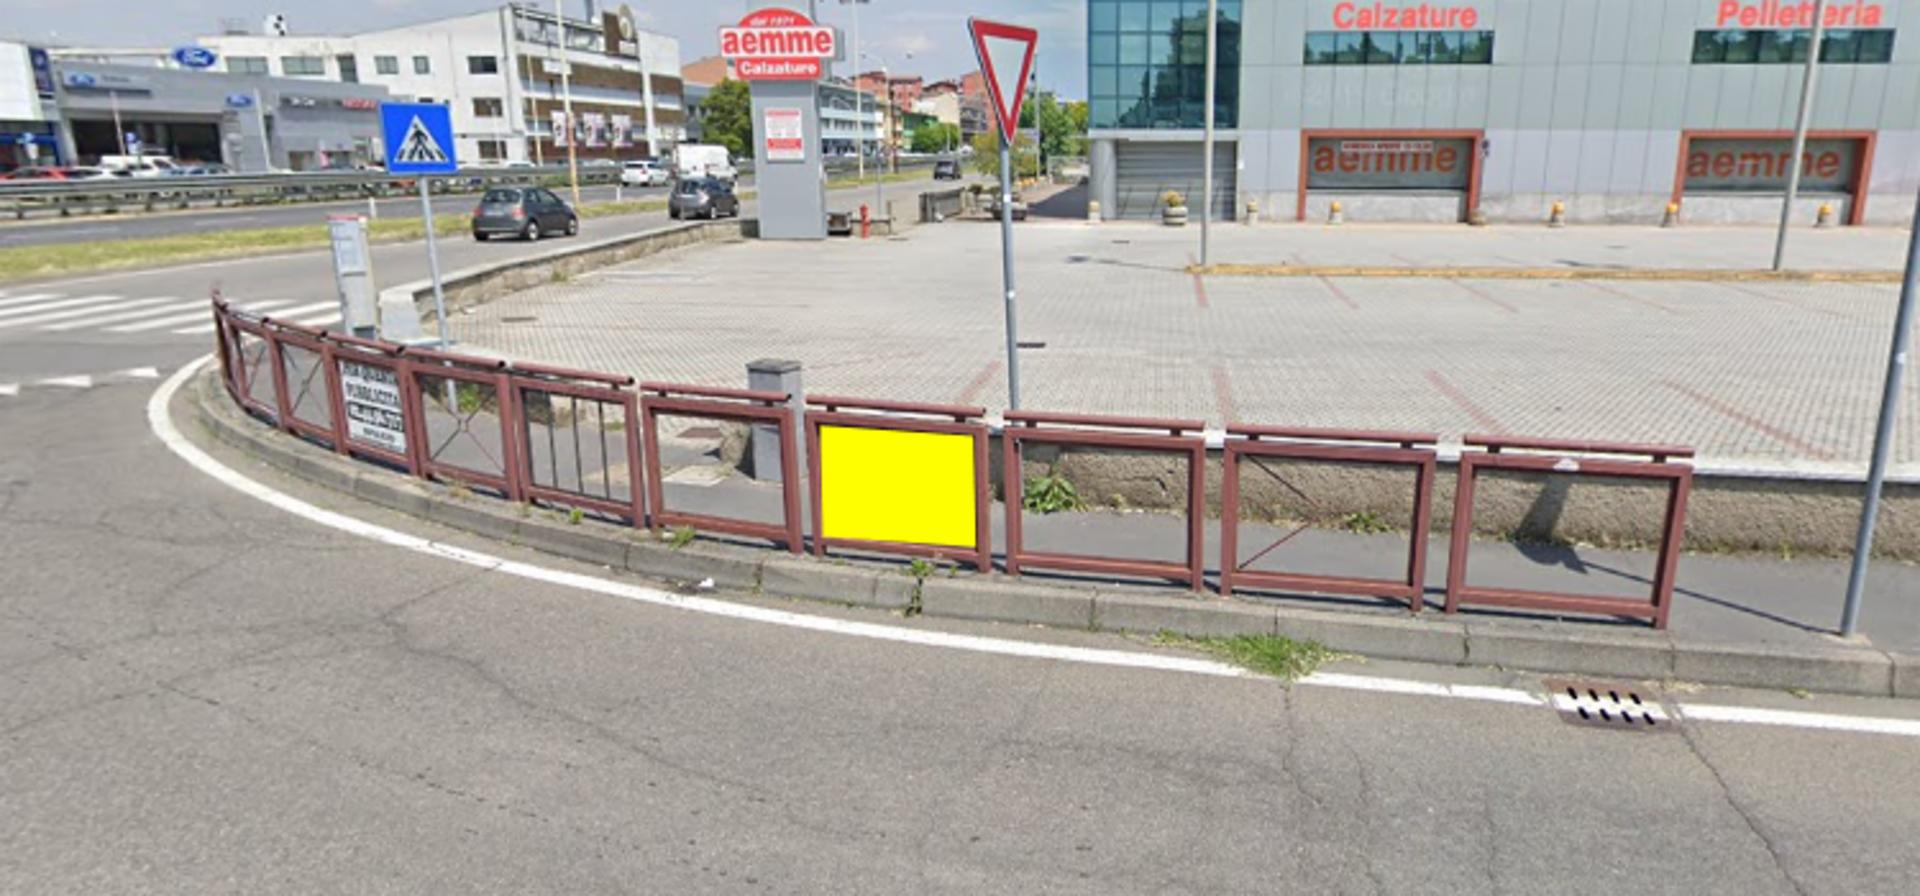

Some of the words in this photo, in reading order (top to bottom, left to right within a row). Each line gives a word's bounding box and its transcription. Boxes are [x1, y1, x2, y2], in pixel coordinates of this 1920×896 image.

[1333, 2, 1478, 30] Calzature
[722, 30, 832, 54] aemme
[740, 60, 817, 75] Calzature
[1313, 143, 1457, 173] aemme
